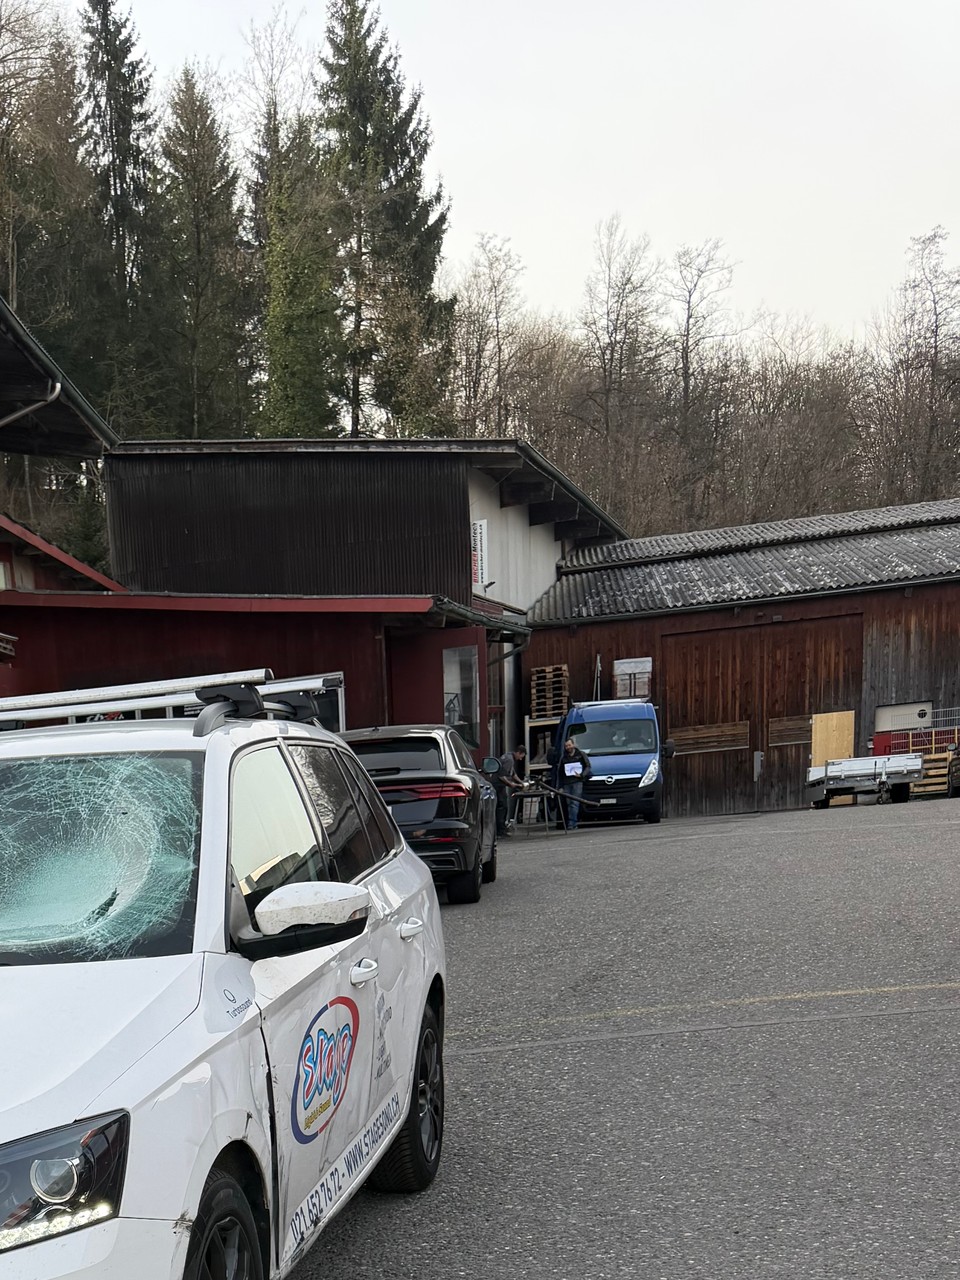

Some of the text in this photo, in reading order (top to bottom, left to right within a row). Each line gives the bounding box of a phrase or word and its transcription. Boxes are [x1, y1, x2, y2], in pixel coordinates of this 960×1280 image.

[226, 997, 253, 1019] Turbosound
[302, 1023, 352, 1110] Stage
[320, 1181, 333, 1207] 76
[330, 1167, 343, 1196] 72
